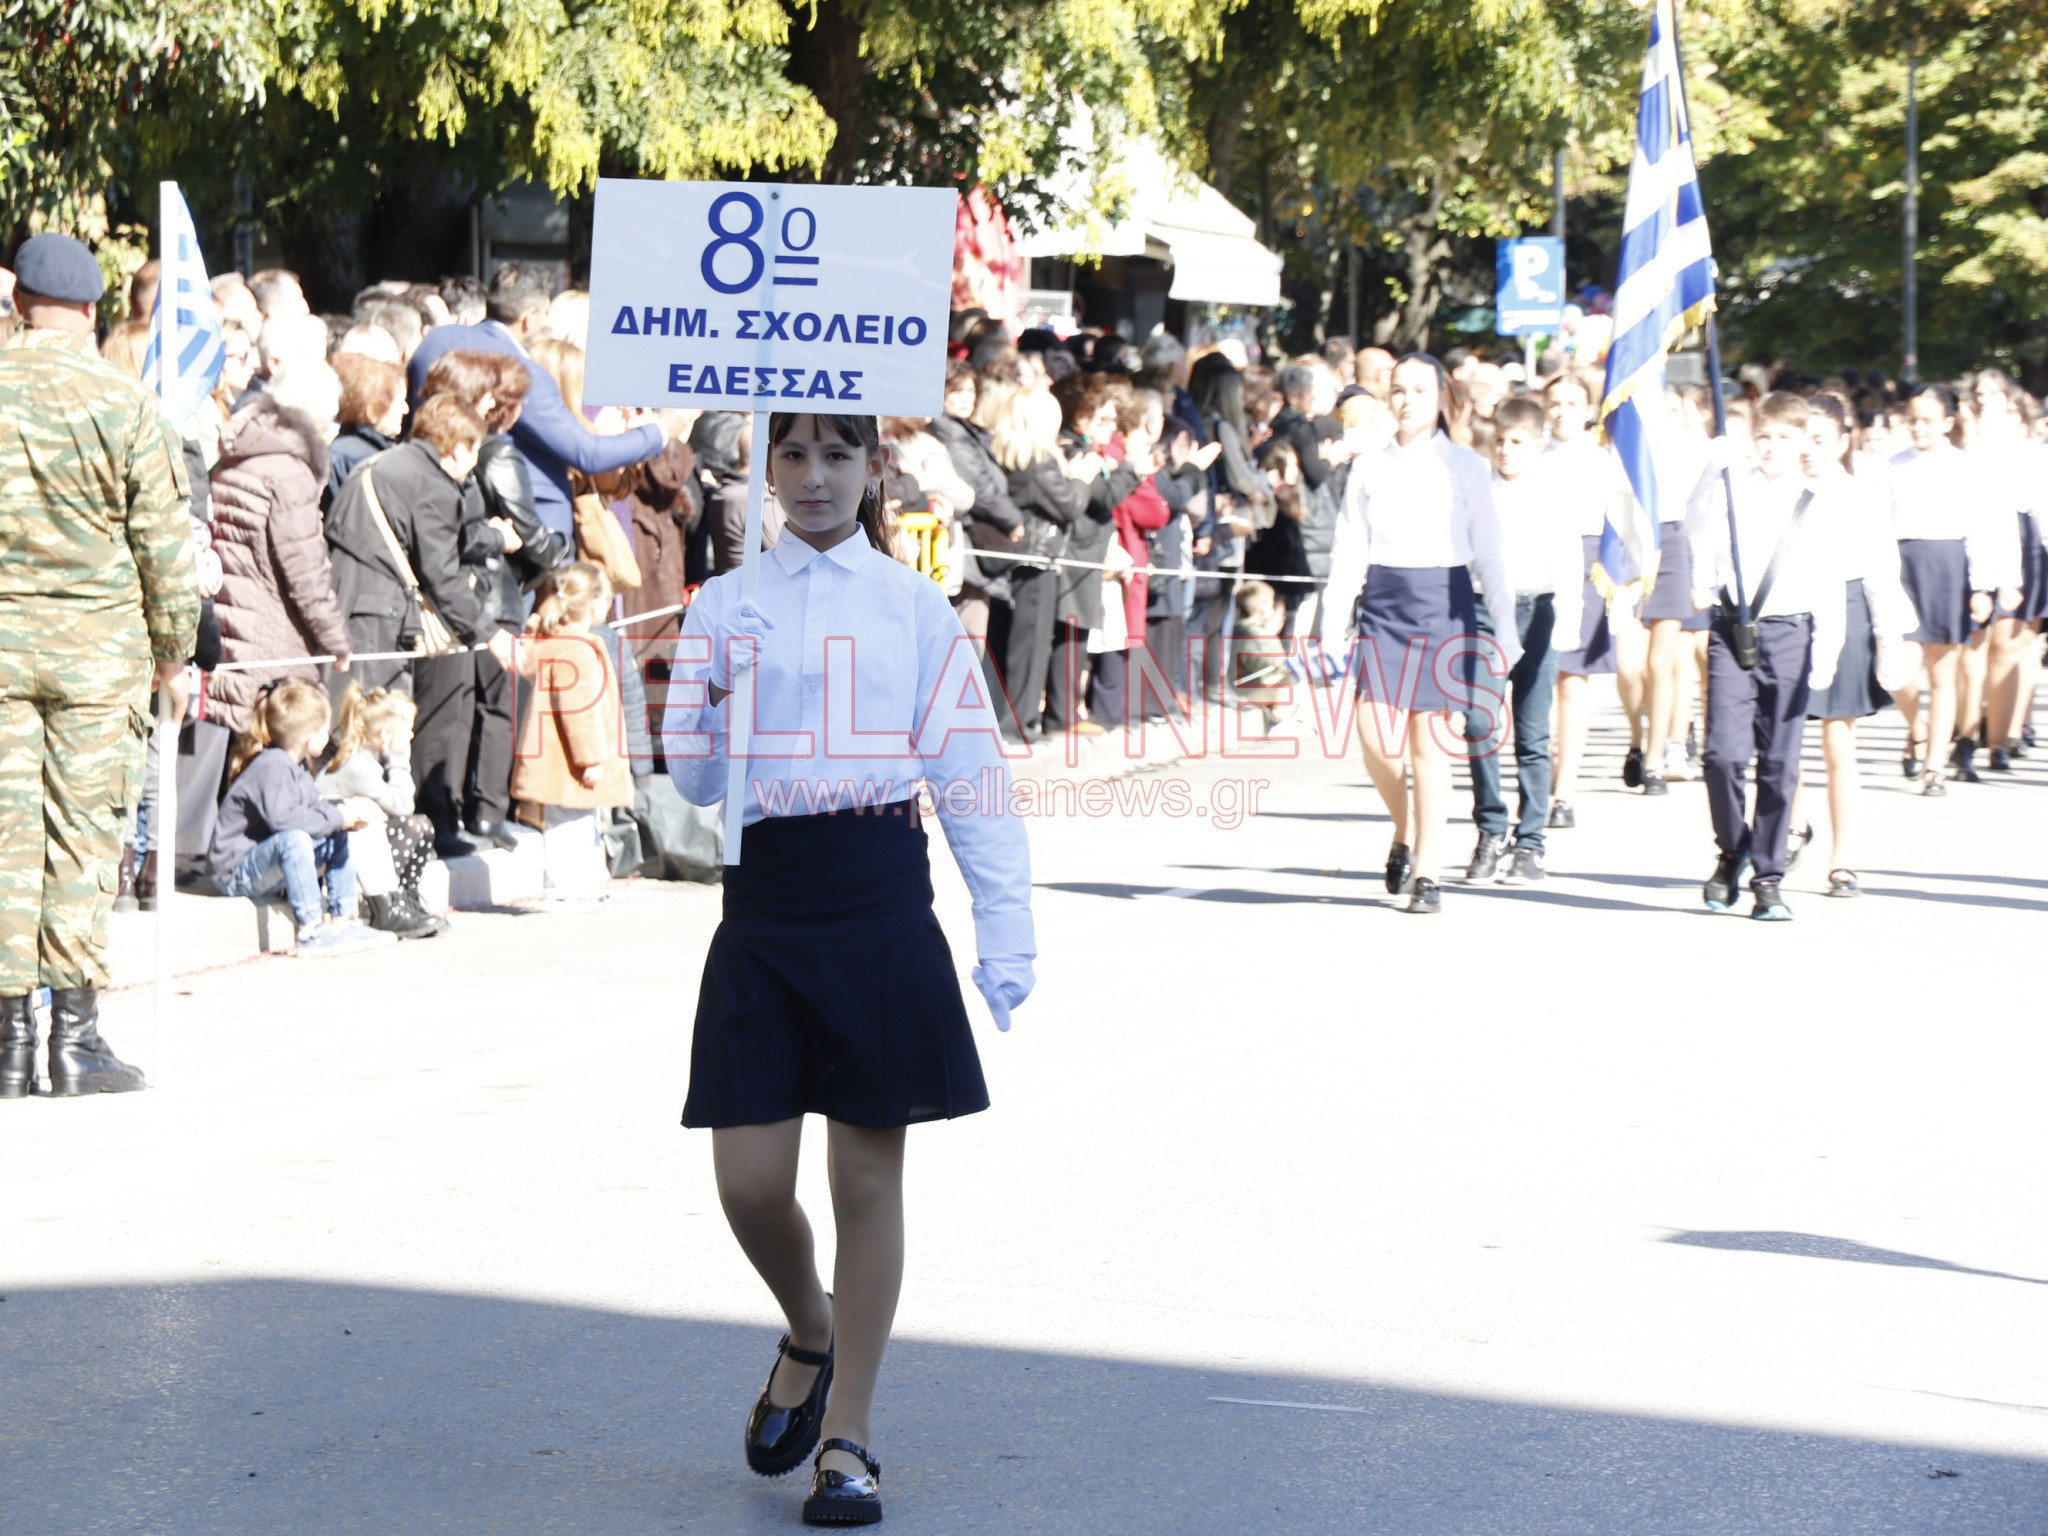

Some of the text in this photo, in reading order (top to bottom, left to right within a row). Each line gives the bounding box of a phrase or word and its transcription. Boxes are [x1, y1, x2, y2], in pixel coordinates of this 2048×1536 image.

[611, 306, 927, 346] ΔΗΜ. ΣΧΟΛΕΙΟ
[668, 364, 863, 400] ΕΔΕΣΣΑΣ
